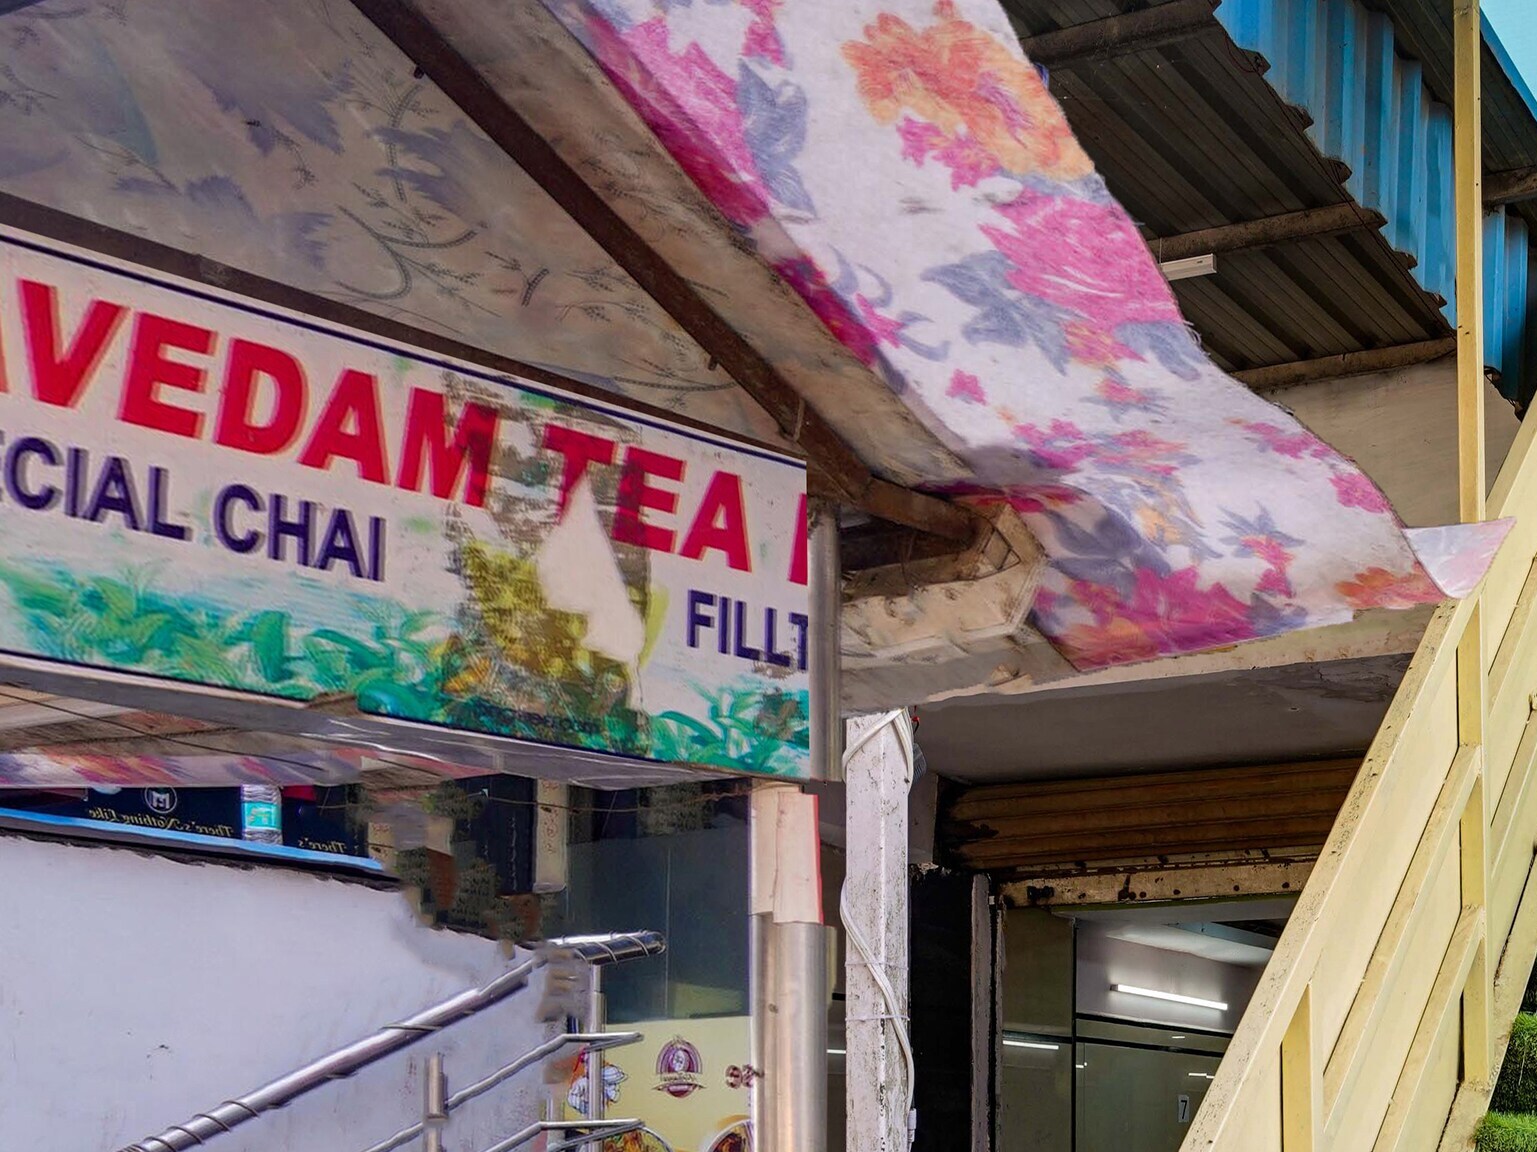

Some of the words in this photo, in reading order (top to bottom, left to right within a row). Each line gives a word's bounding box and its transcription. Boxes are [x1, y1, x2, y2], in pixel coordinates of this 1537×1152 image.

[0, 277, 499, 508] VEDAM
[544, 424, 754, 573] TEA
[0, 436, 194, 542] CIAL
[213, 483, 387, 583] CHAI
